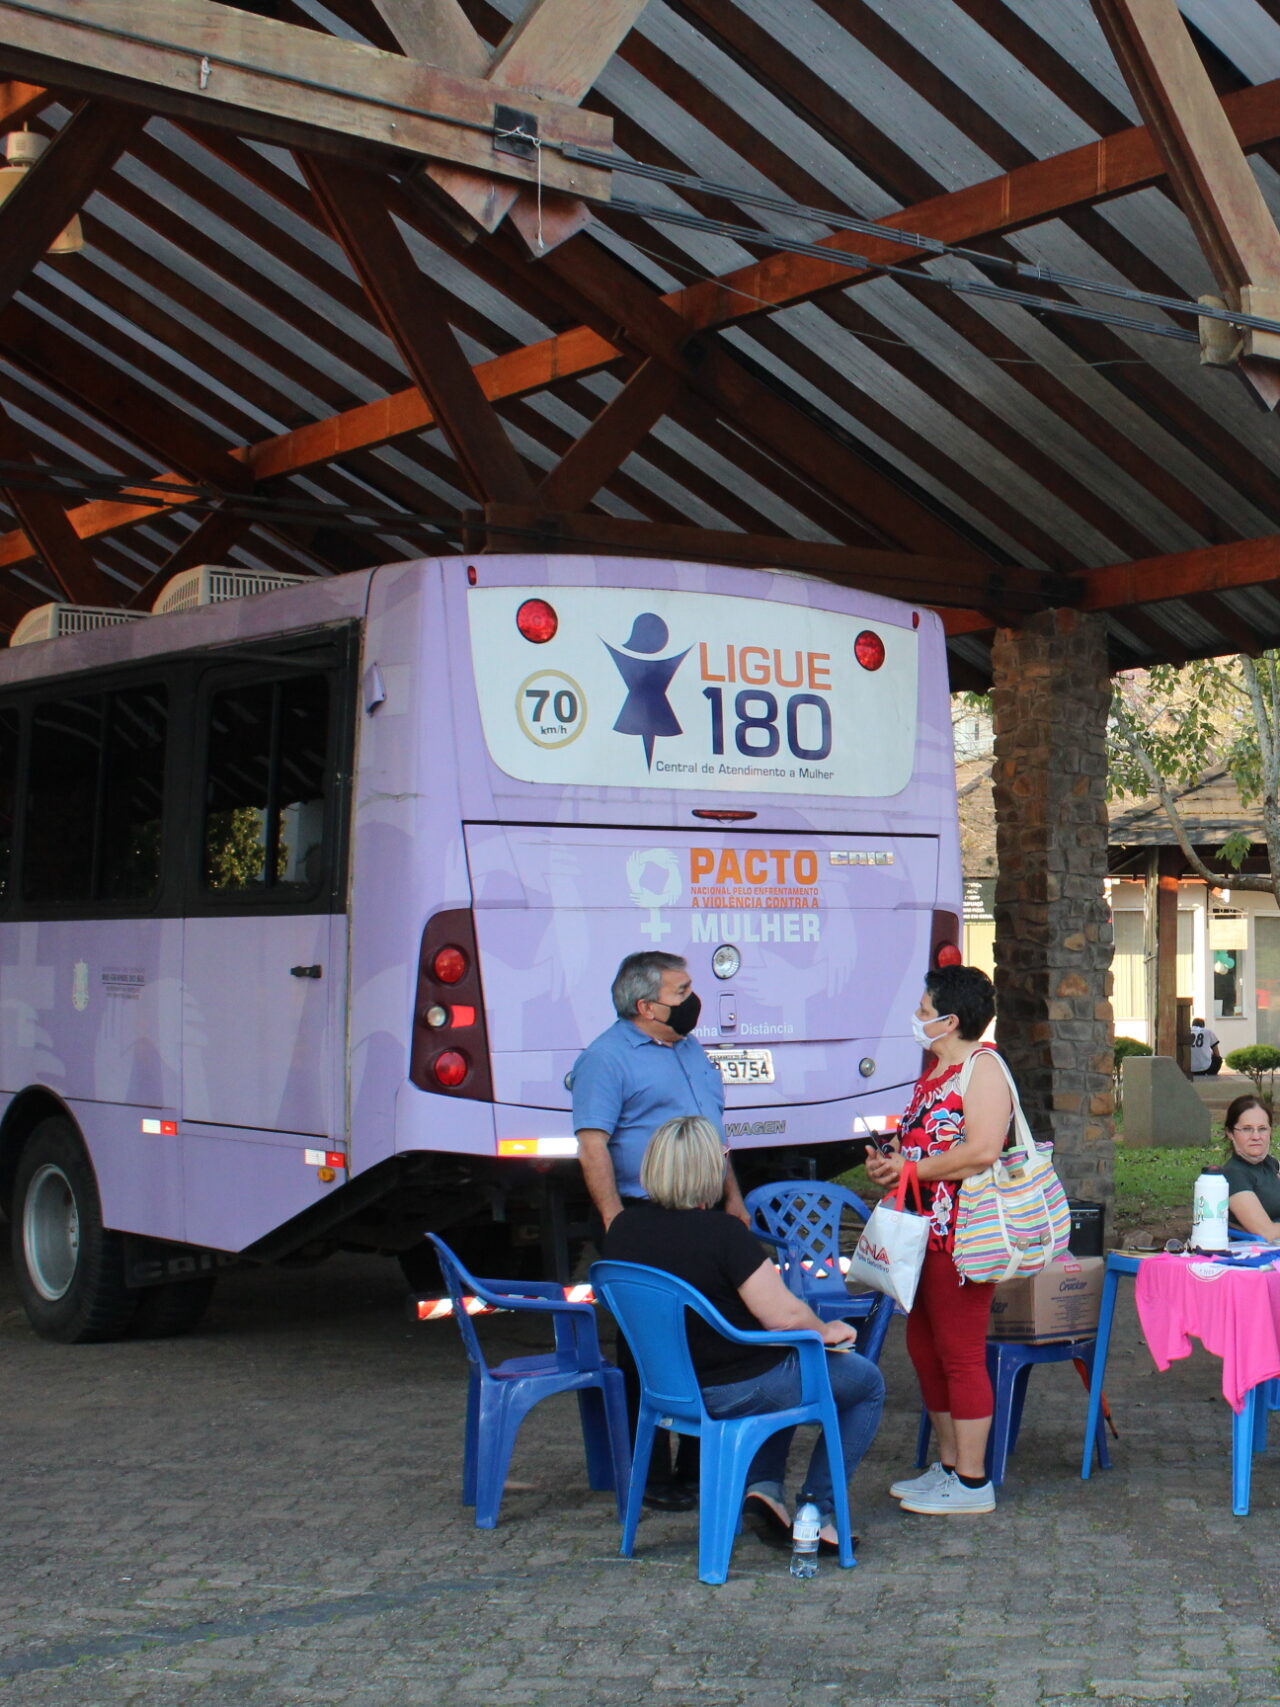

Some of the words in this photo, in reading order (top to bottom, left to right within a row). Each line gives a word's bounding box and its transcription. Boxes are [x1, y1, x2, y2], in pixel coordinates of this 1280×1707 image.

[700, 642, 832, 691] LIGUE
[526, 690, 578, 723] 70
[541, 725, 567, 735] km/h
[702, 687, 832, 761] 180
[656, 760, 697, 773] Central
[701, 763, 715, 774] de
[718, 763, 786, 777] Atendimento
[789, 769, 796, 778] a
[799, 768, 834, 779] Mulher
[690, 848, 818, 885] PACTO
[691, 886, 731, 895] NACIONAL
[733, 887, 753, 895] PELO
[754, 887, 819, 896] ENFRENTAMENTO
[692, 897, 700, 908] A
[702, 895, 762, 908] VIOLÊNCIA
[766, 897, 809, 908] CONTRA
[811, 897, 819, 908] A
[691, 912, 820, 943] MULHER
[740, 1022, 794, 1035] Distância
[725, 1120, 786, 1137] WAGEN
